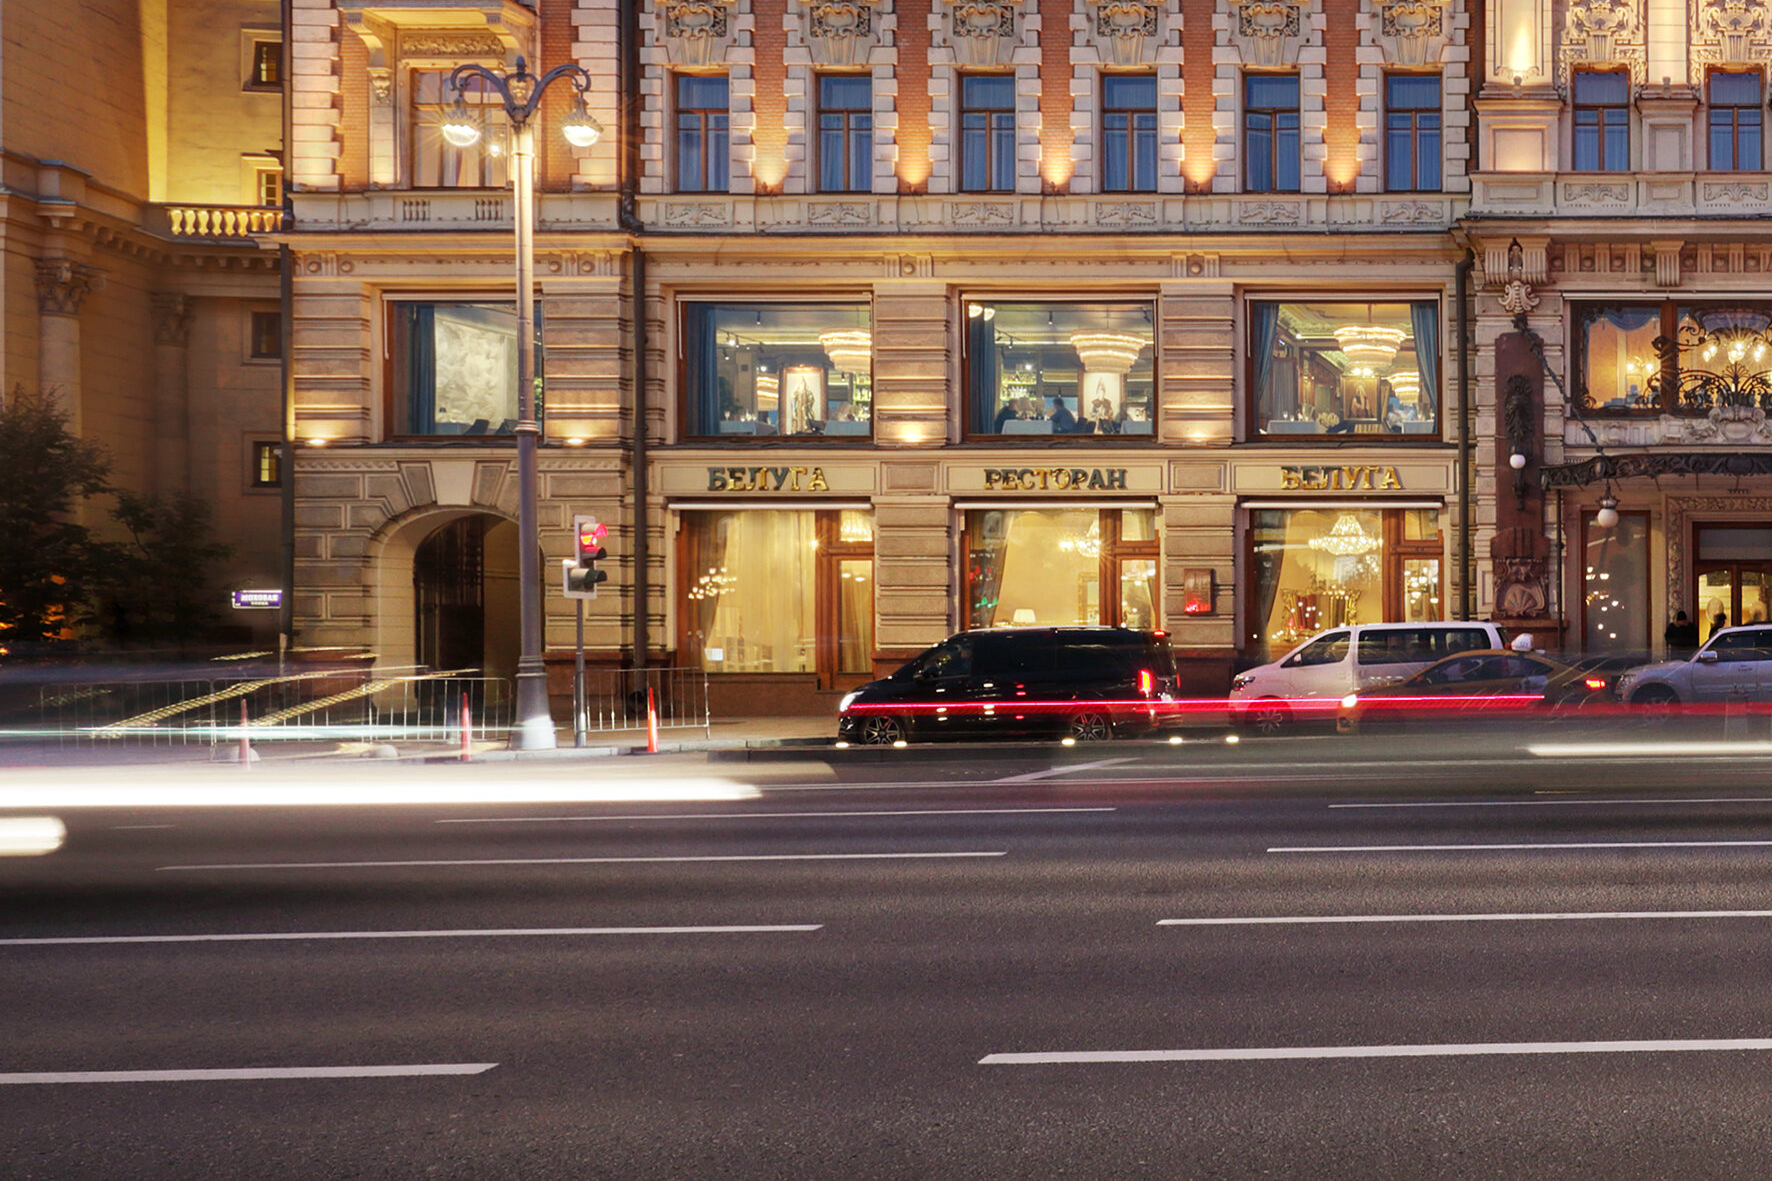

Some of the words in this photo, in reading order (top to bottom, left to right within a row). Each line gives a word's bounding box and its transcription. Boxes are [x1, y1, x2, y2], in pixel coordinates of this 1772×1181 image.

[707, 466, 830, 491] БЕЛУГА
[983, 468, 1129, 490] РЕСТОРАН
[1280, 465, 1403, 490] БЕЛУГА
